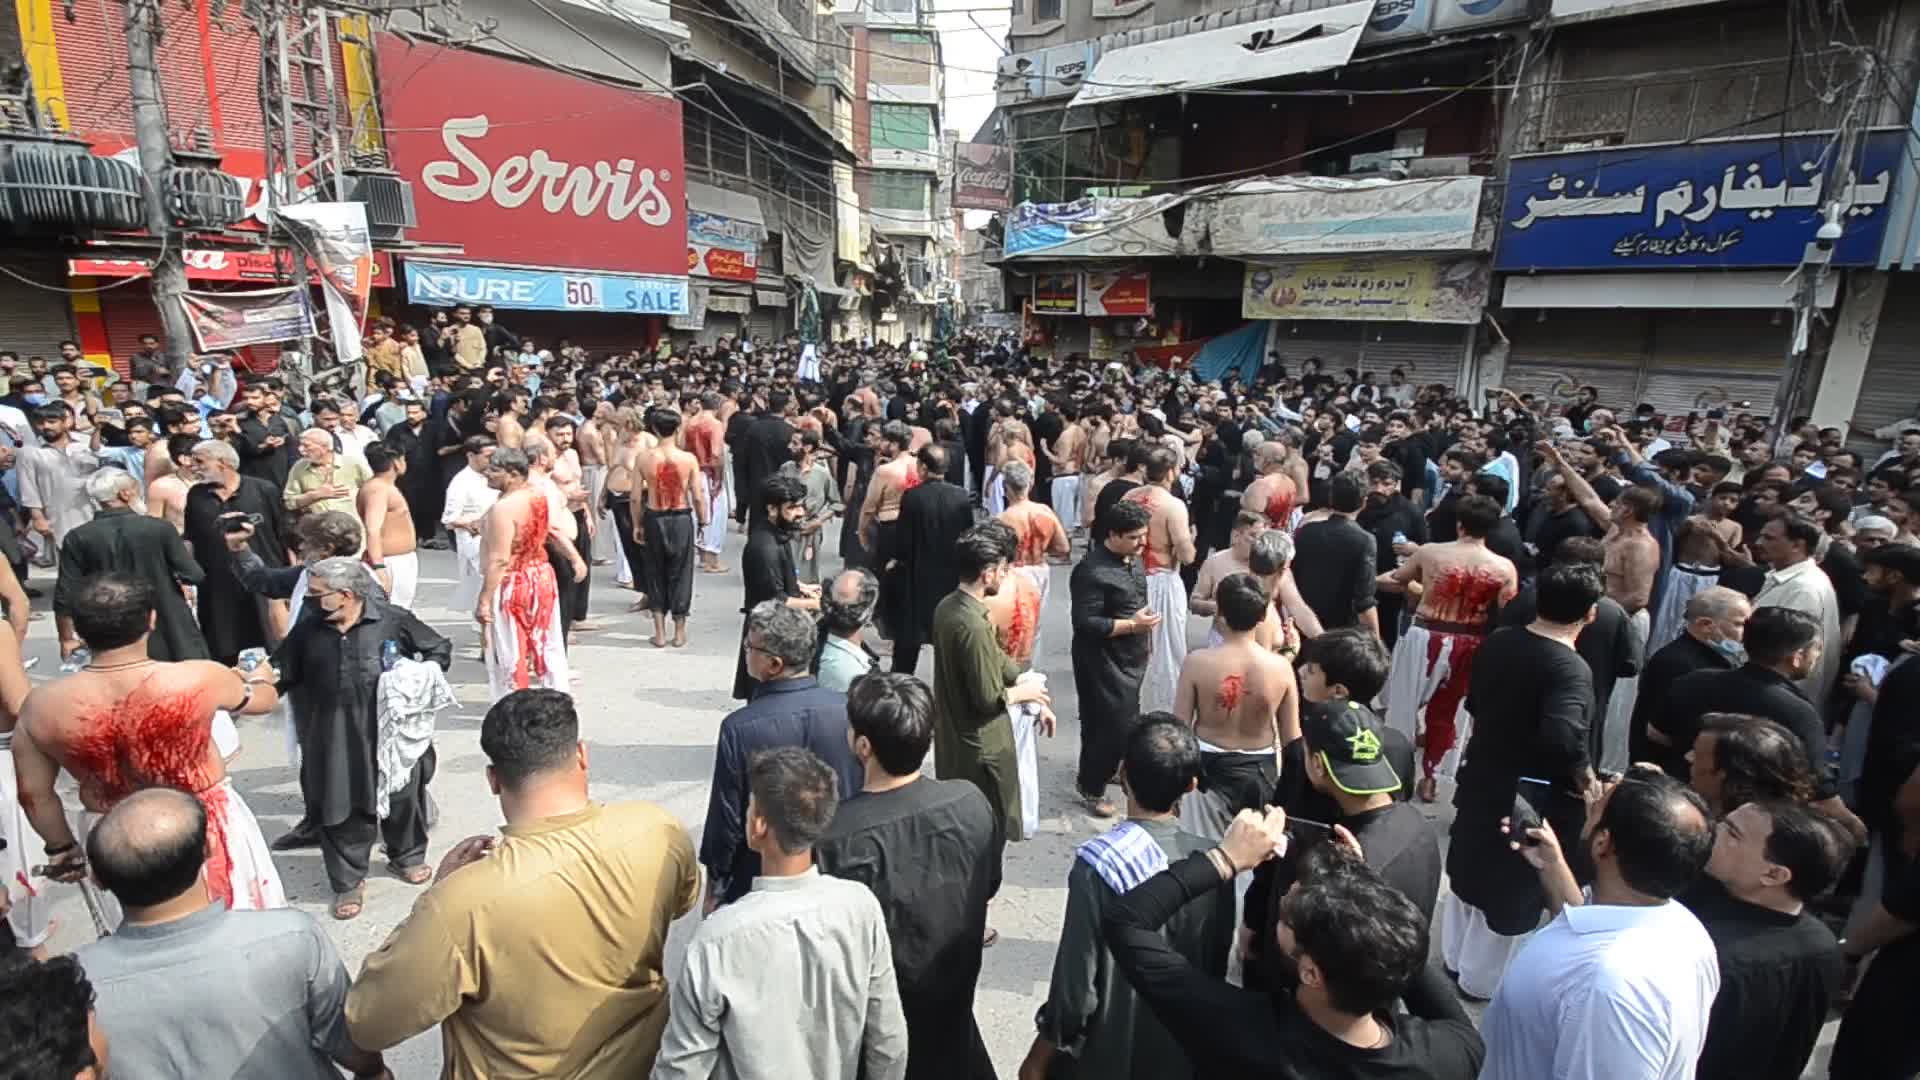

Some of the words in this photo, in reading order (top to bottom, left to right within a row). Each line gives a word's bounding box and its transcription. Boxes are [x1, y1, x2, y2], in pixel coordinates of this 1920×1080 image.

[1056, 61, 1086, 74] PEPSI
[422, 114, 672, 226] Servis
[567, 281, 593, 305] 50
[625, 290, 681, 311] SALE
